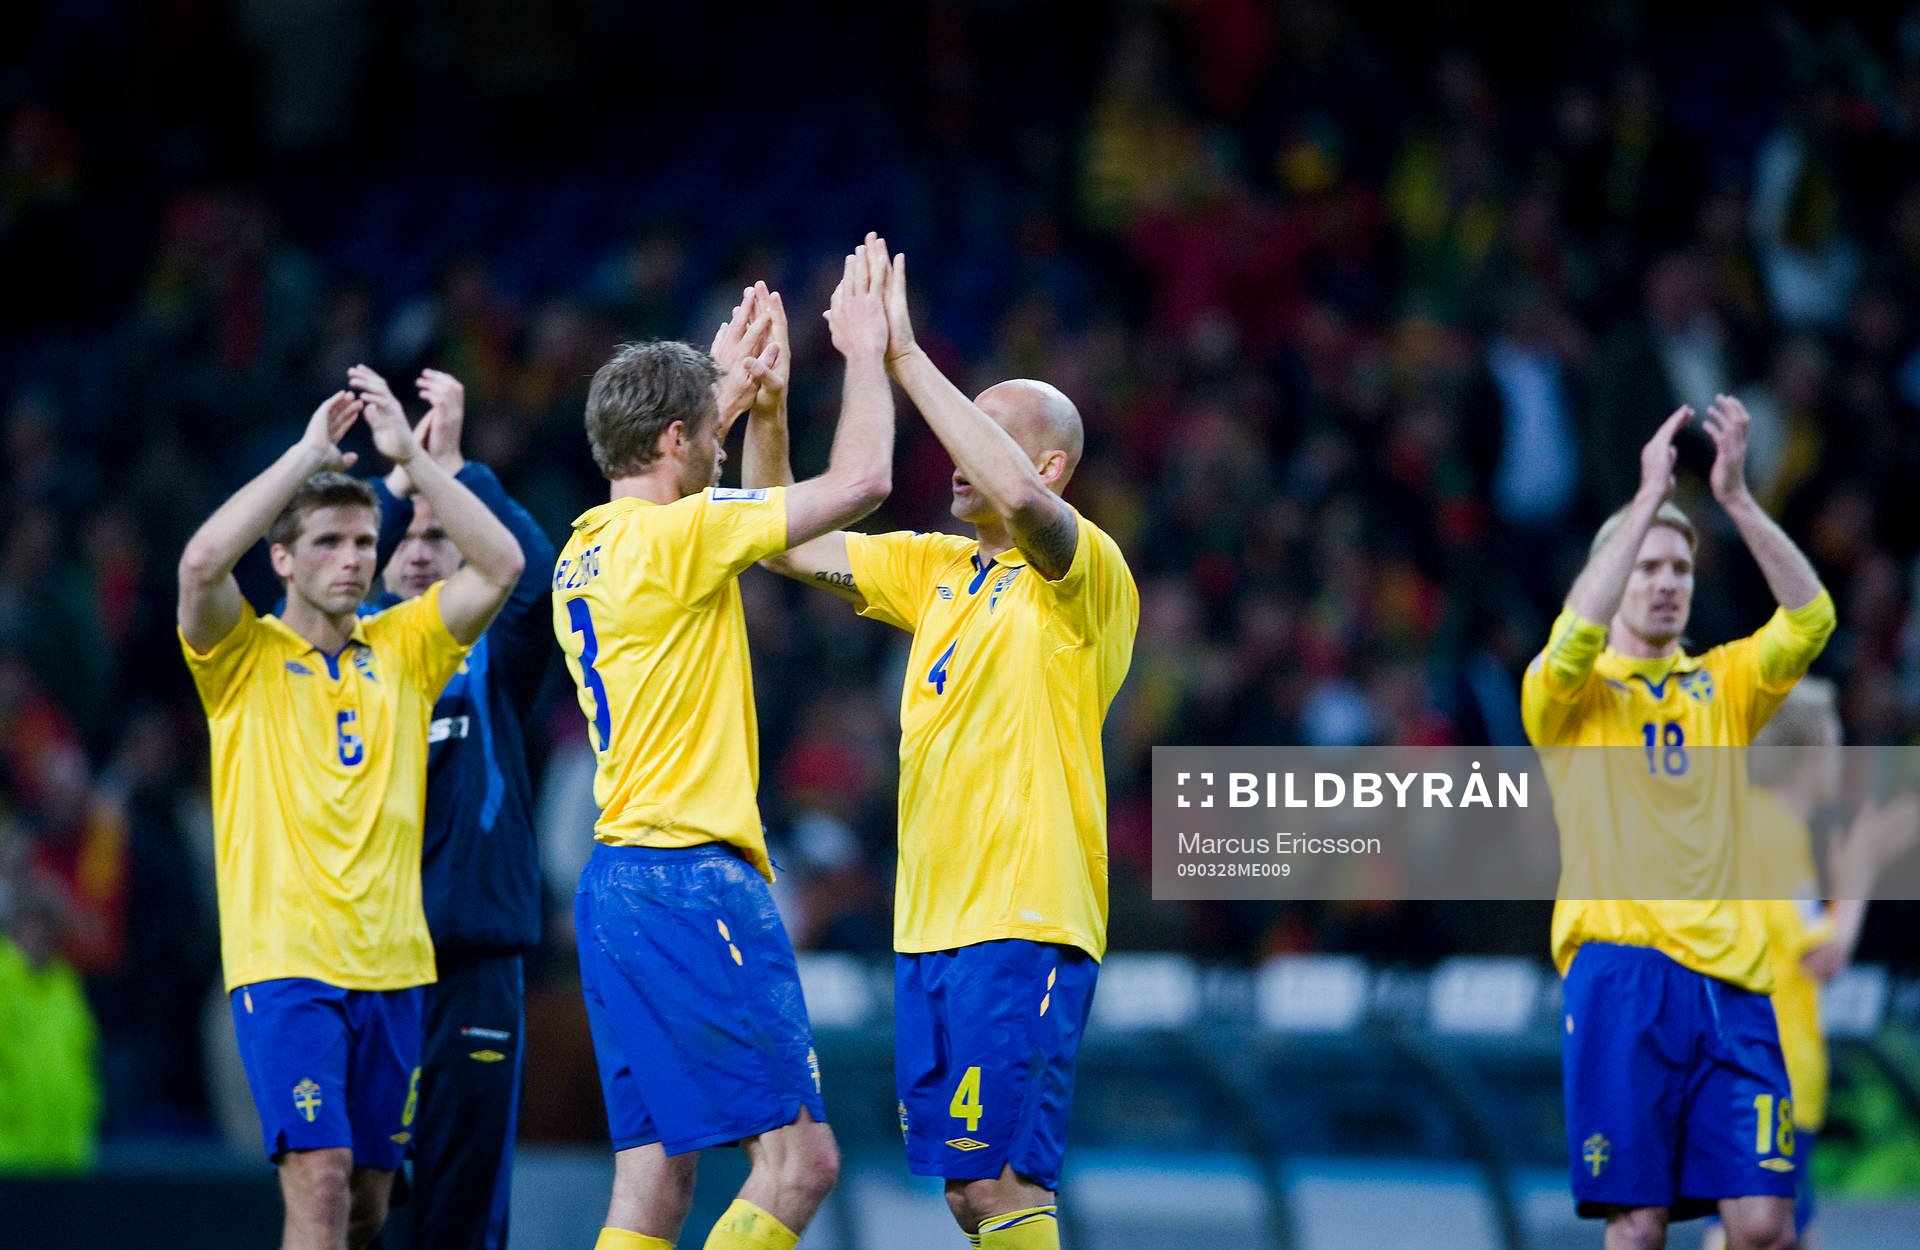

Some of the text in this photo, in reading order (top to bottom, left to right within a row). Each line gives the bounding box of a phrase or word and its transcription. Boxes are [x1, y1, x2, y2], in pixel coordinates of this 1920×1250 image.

[566, 597, 611, 752] 3
[928, 638, 958, 696] 4
[336, 710, 364, 767] 6
[1641, 720, 1690, 777] 18
[949, 1066, 983, 1132] 4
[1753, 1093, 1795, 1157] 18
